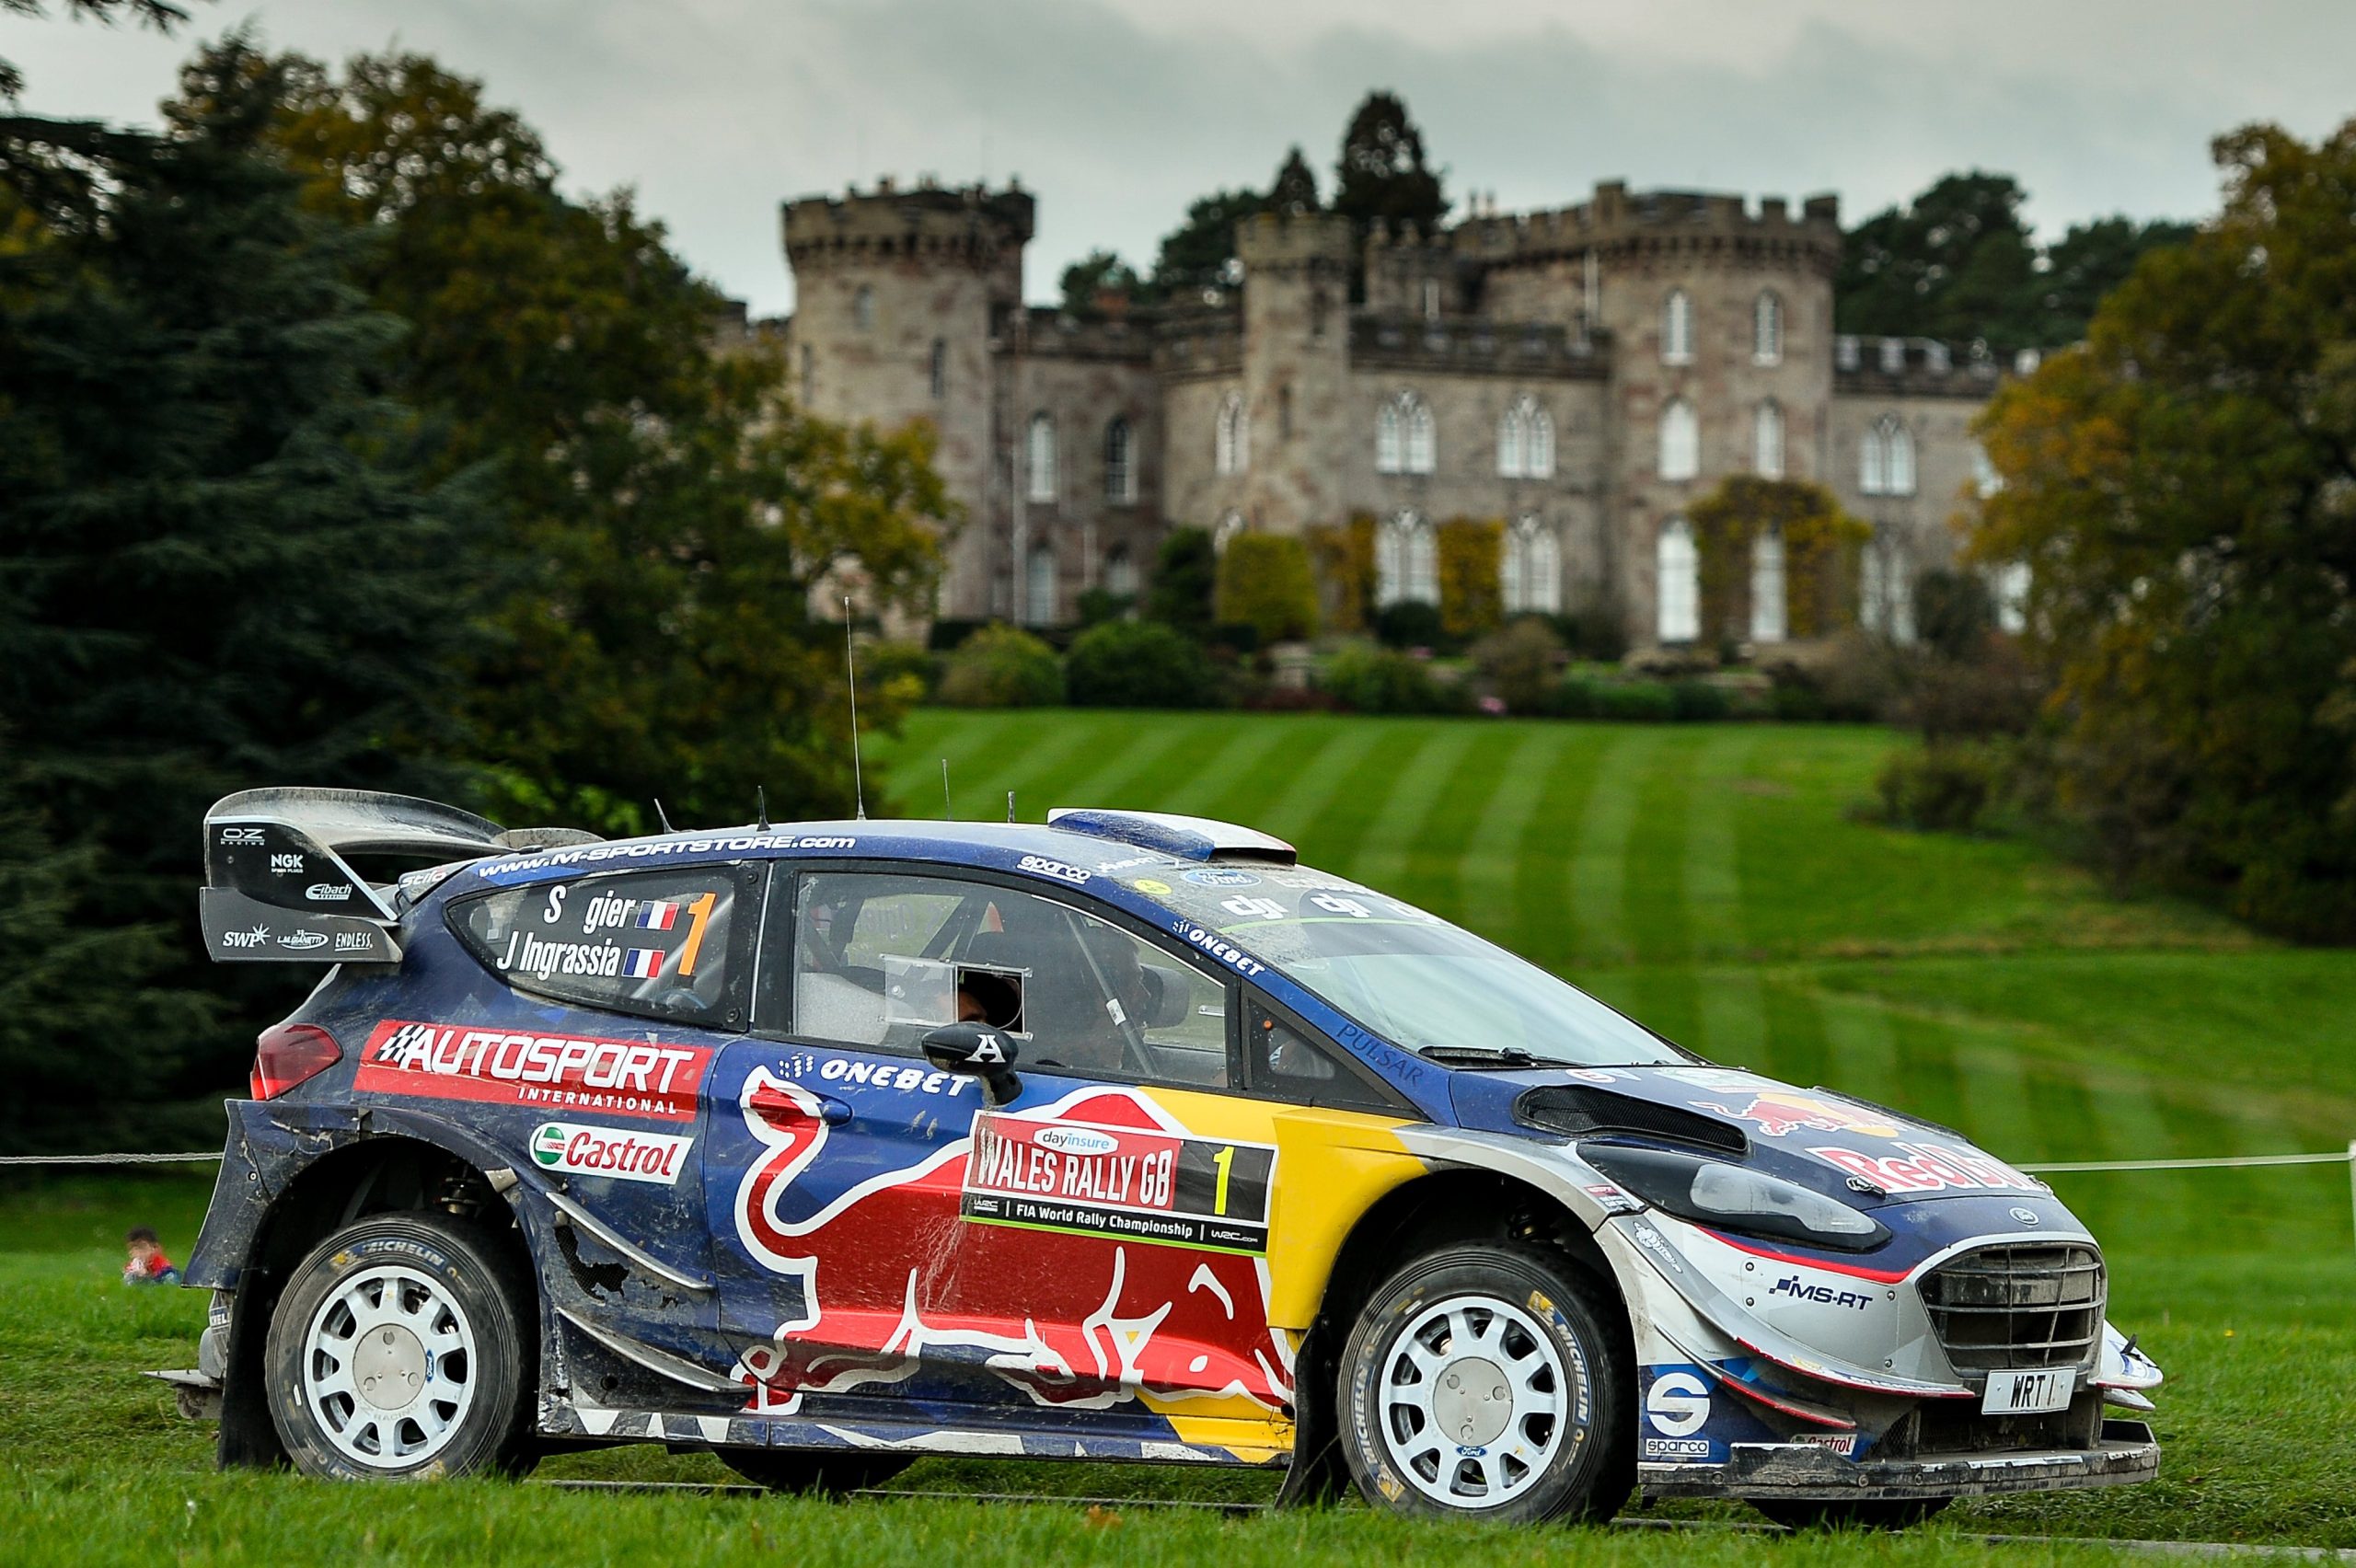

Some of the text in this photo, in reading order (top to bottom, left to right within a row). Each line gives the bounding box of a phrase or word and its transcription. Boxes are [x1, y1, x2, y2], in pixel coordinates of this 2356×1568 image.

[271, 854, 304, 868] NGK
[479, 836, 856, 878] www.M-SPORTSTORE.com
[1017, 855, 1091, 885] sparco
[306, 883, 352, 900] Eibach
[543, 885, 566, 924] S
[1220, 894, 1288, 919] dji
[1311, 894, 1372, 917] dji
[222, 931, 260, 947] SWP
[678, 892, 717, 976] 1
[497, 930, 622, 981] J Ingrassia
[1188, 928, 1265, 977] ONEBET
[399, 1028, 695, 1094] AUTOSPORT
[964, 1034, 1006, 1063] A
[1336, 1023, 1425, 1087] PULSAR
[820, 1058, 977, 1098] ONEBET
[517, 1088, 677, 1114] INTERNATIONAL
[566, 1132, 678, 1177] Castrol
[1042, 1131, 1110, 1150] dayinsure
[978, 1126, 1173, 1207] WALES RALLY GB
[1213, 1146, 1235, 1216] 1
[1016, 1204, 1036, 1217] FIA
[1038, 1207, 1073, 1223] World
[1076, 1211, 1107, 1228] Rally
[1109, 1216, 1194, 1239] Championship
[363, 1240, 445, 1266] MICHELIN
[1556, 1323, 1588, 1423] MICHELIN
[2010, 1375, 2046, 1408] WRT
[1647, 1441, 1708, 1454] sparco
